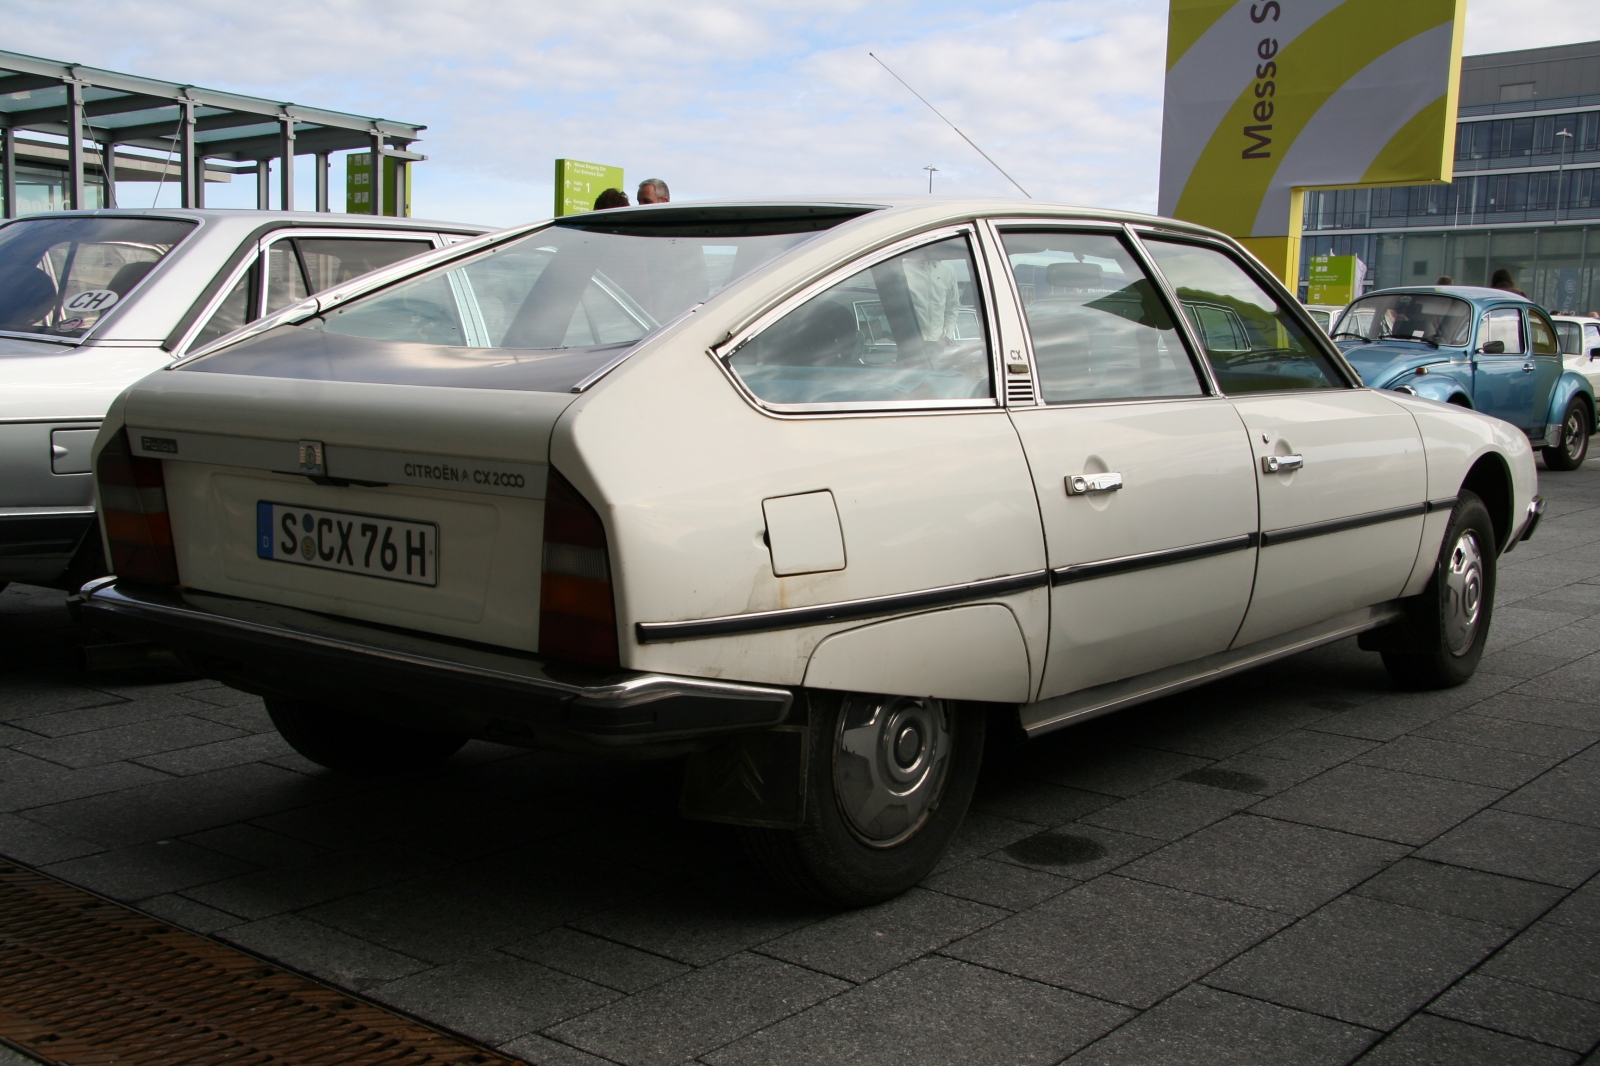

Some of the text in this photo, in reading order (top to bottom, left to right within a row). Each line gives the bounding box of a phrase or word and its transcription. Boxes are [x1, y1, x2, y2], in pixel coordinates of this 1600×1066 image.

[1242, 0, 1281, 160] Messe S
[586, 182, 590, 193] 1
[69, 292, 112, 309] CH
[1010, 349, 1023, 361] CX
[404, 463, 459, 482] CITROËN
[262, 536, 269, 548] D
